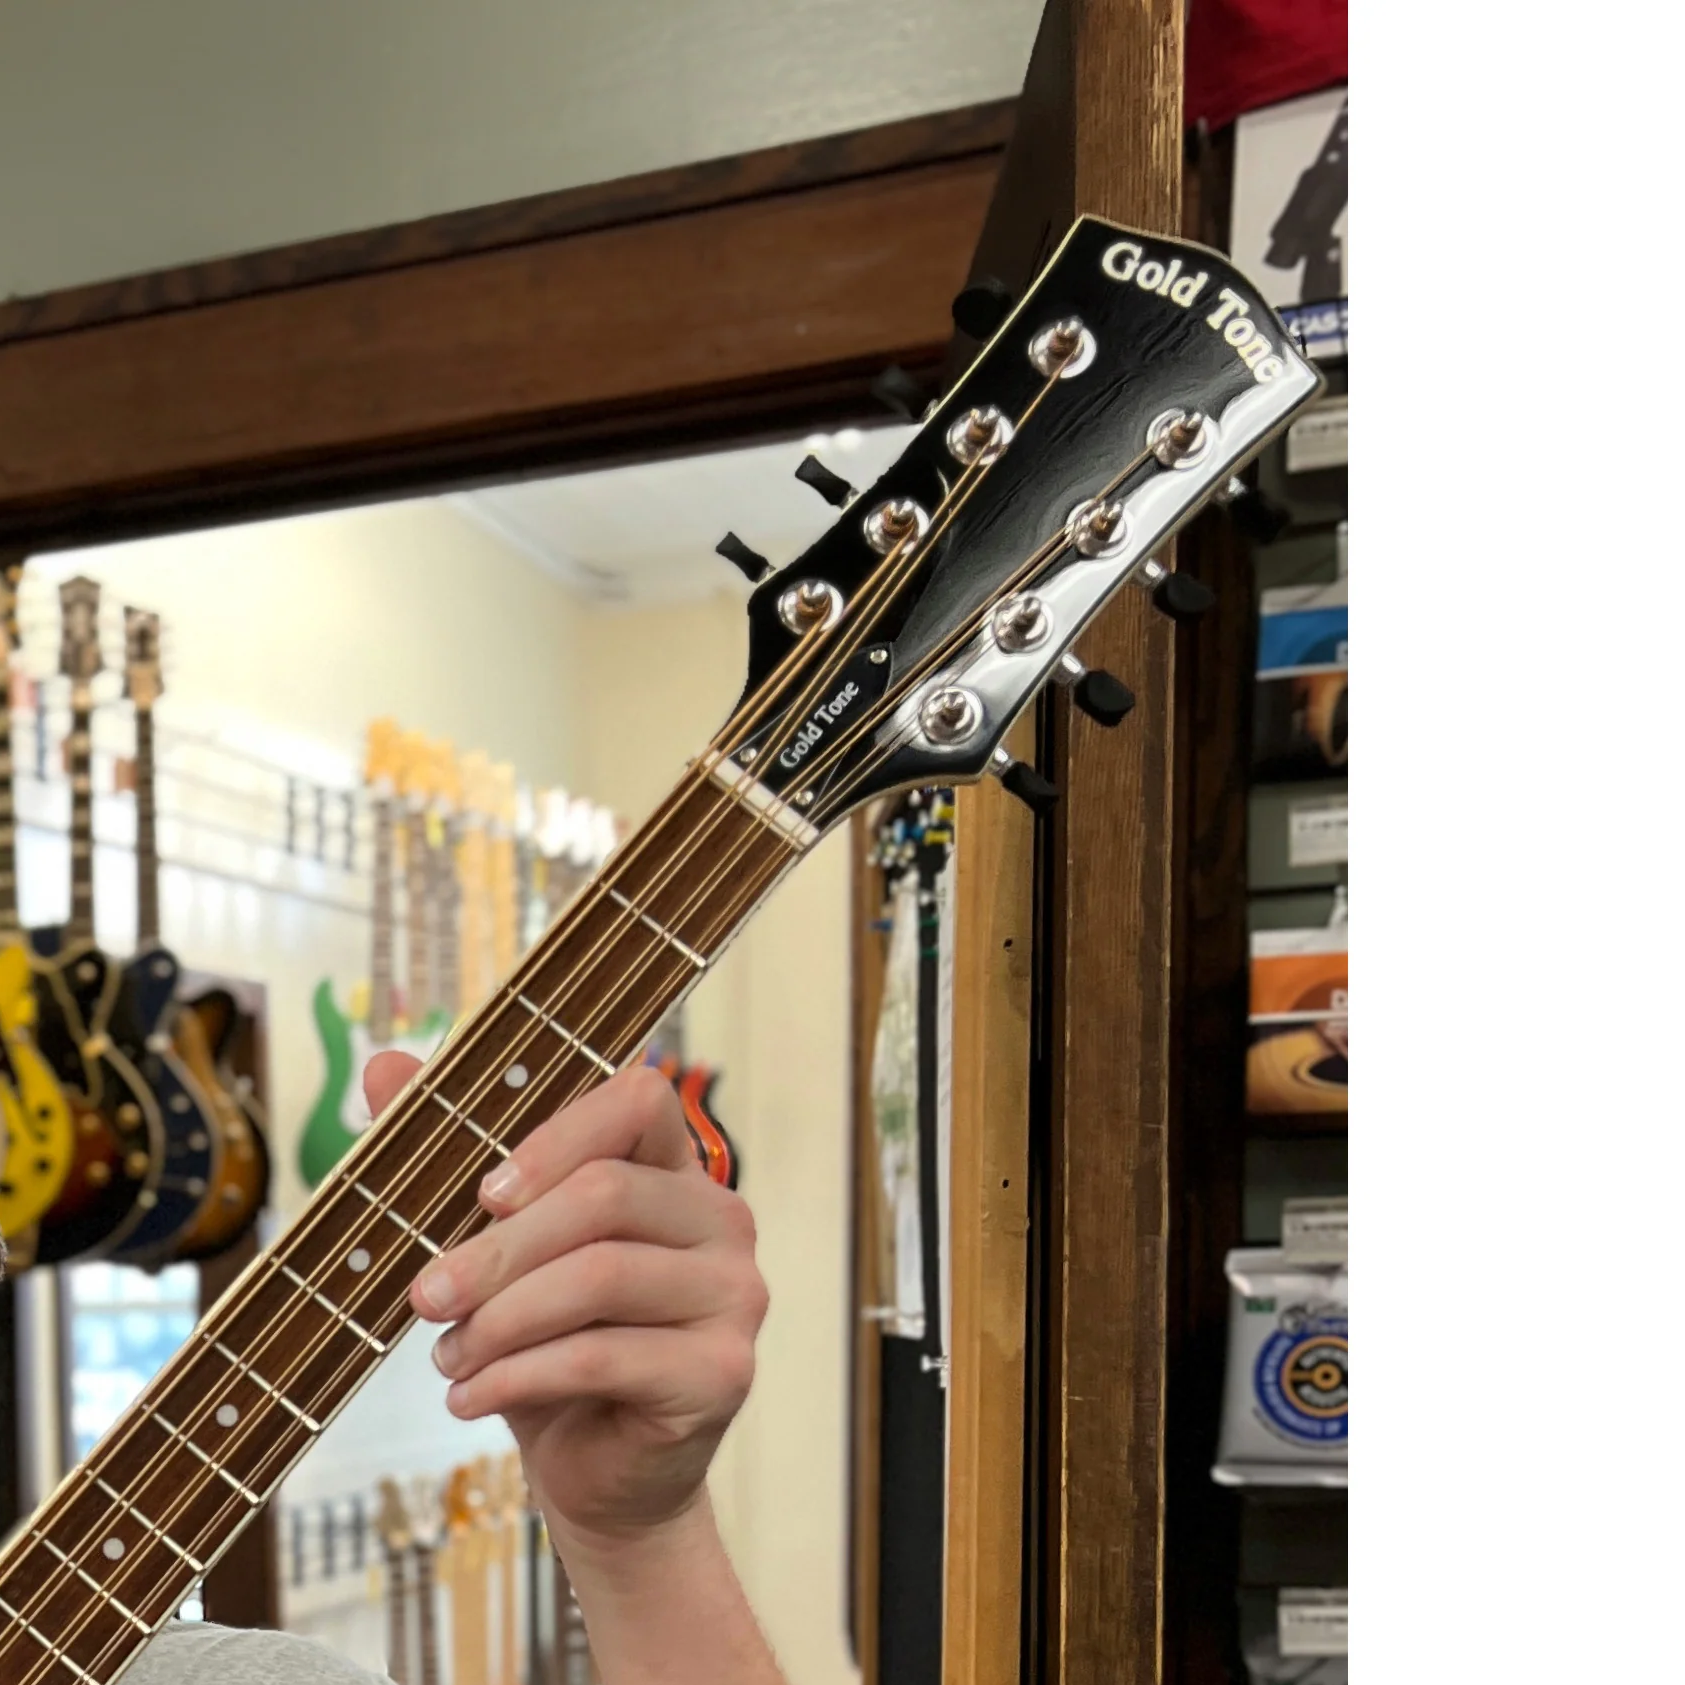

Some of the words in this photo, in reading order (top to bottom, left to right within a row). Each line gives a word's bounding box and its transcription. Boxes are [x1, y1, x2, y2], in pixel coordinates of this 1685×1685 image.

[1102, 241, 1208, 308] Gold
[1206, 288, 1284, 384] Tone
[779, 720, 824, 769] Gold
[813, 681, 860, 725] Tone
